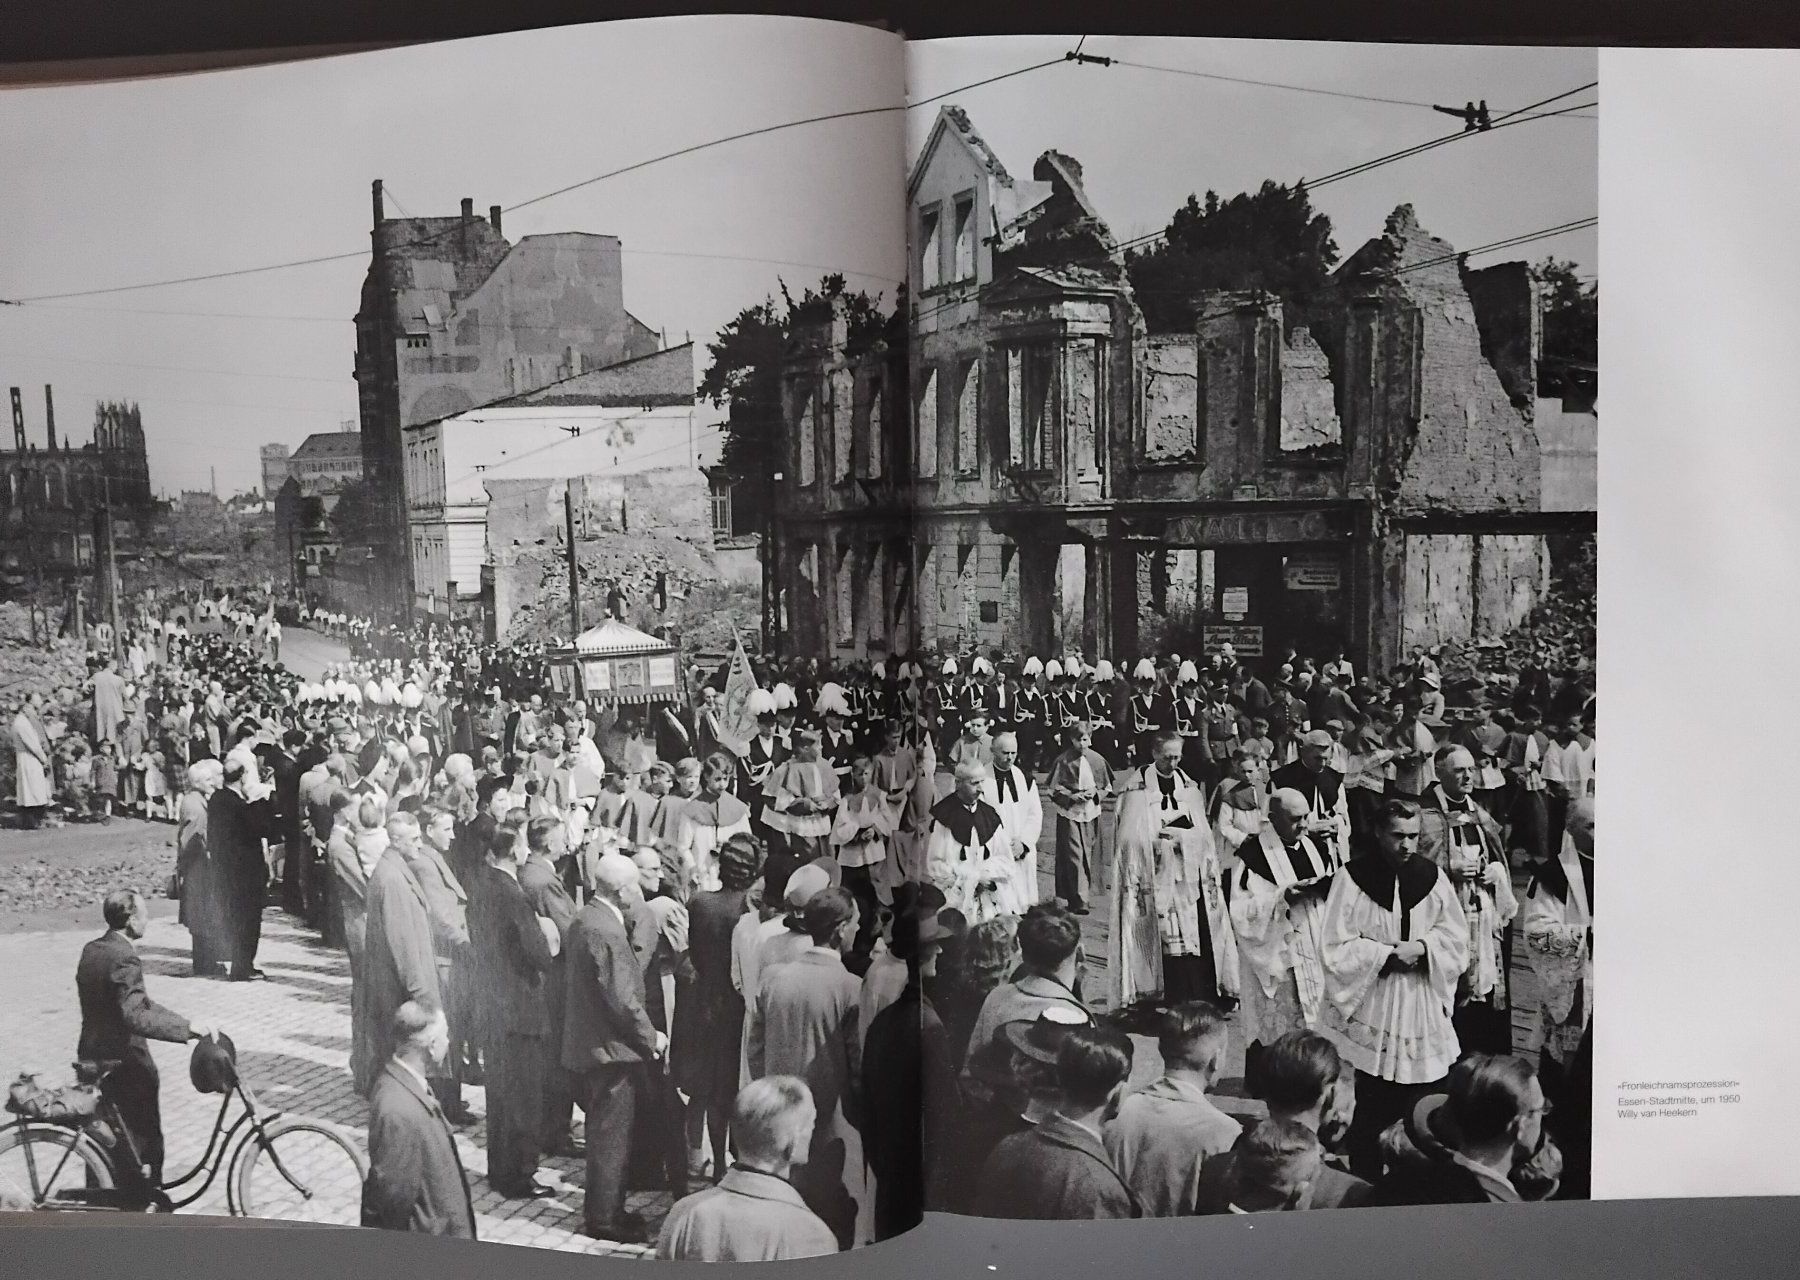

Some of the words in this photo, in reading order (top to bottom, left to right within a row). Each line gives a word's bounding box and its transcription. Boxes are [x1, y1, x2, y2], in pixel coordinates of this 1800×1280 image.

[1618, 1096, 1698, 1107] Essen-Stadtmitte,
[1719, 1095, 1740, 1103] 1950
[1617, 1109, 1638, 1119] Willy
[1641, 1110, 1656, 1118] van
[1660, 1108, 1697, 1117] Heekern
